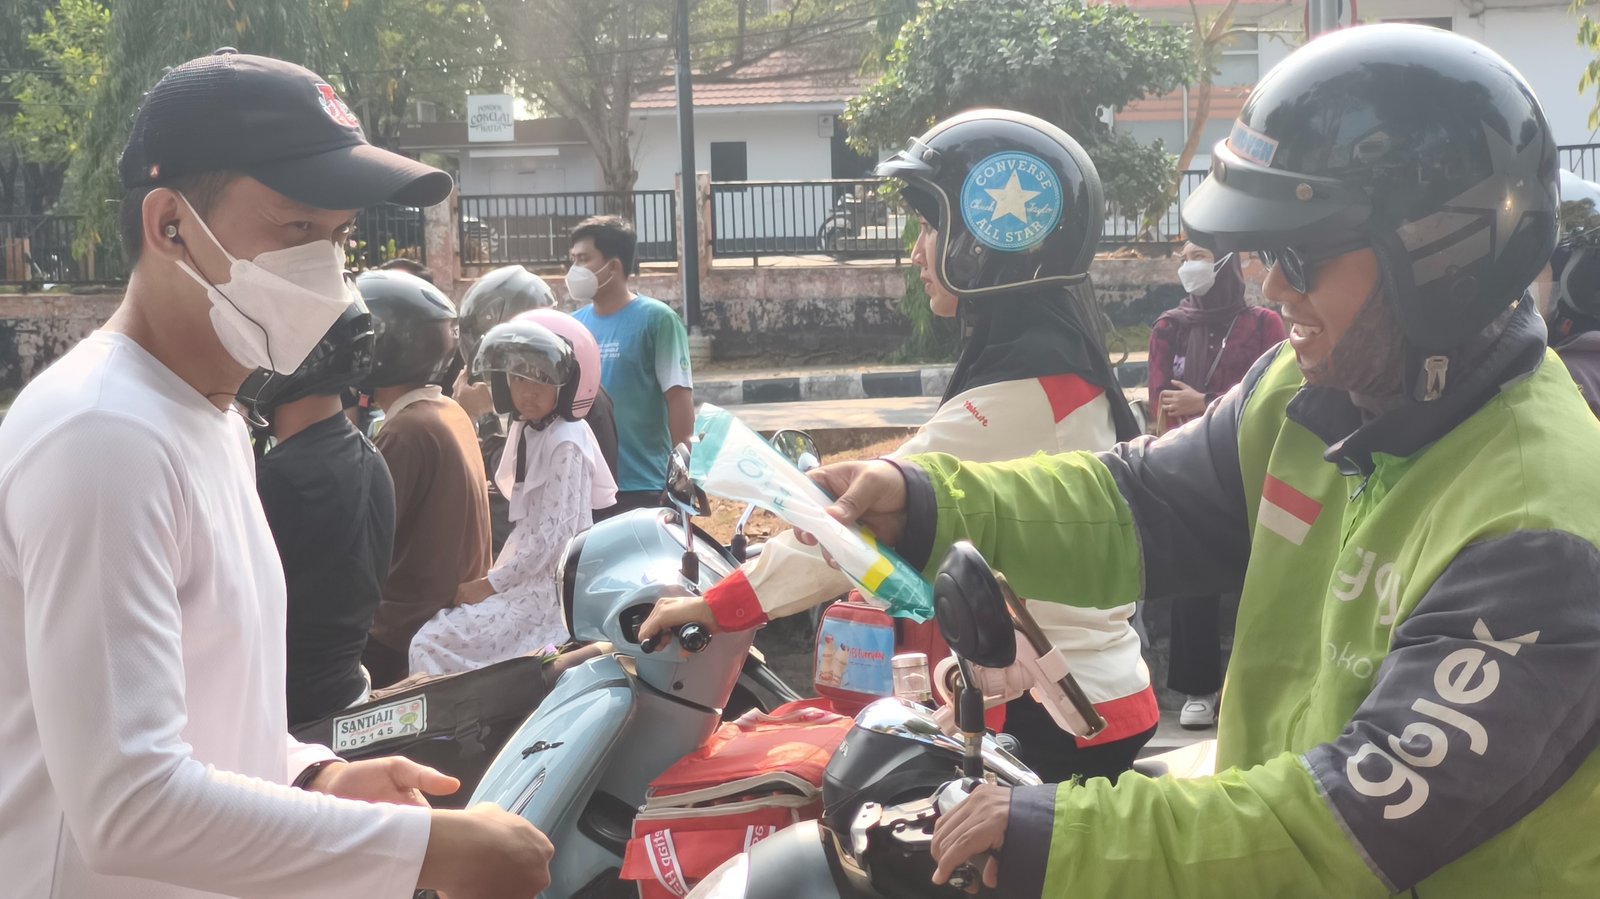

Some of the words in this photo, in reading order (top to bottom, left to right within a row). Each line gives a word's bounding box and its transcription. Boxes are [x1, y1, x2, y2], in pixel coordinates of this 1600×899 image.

[975, 159, 1052, 190] CONVERSE
[976, 218, 1000, 241] ALL
[1005, 220, 1043, 243] STAR
[341, 710, 393, 733] SANTIAJI
[1346, 617, 1541, 820] gojek
